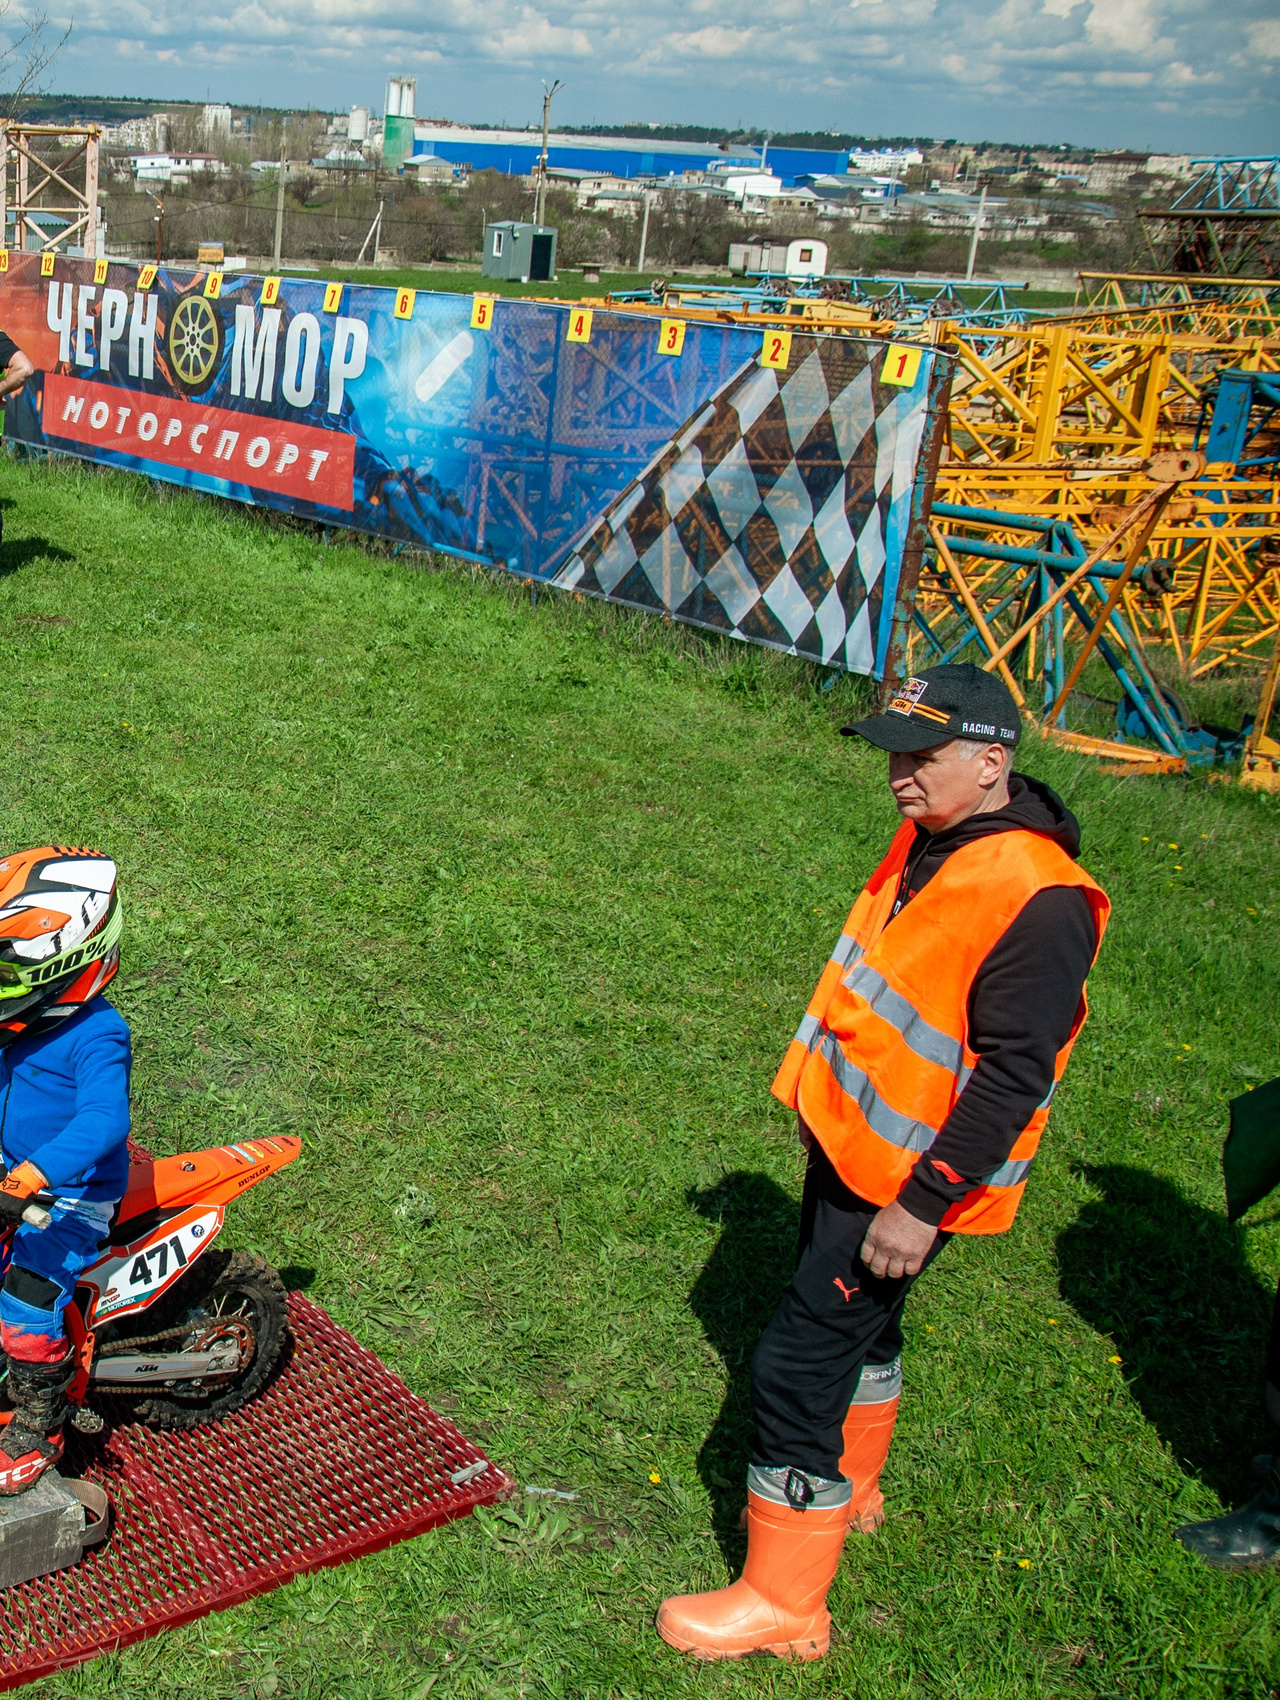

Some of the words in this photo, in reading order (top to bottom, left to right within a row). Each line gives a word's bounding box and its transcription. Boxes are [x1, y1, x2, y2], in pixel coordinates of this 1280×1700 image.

[44, 257, 52, 272] 12
[97, 265, 105, 279] 11
[140, 270, 153, 285] 10
[209, 278, 218, 294] 9
[265, 283, 274, 299] 8
[328, 290, 337, 307] 7
[399, 294, 408, 313] 6
[477, 304, 487, 325] 5
[574, 315, 584, 337] 4
[666, 326, 678, 349] 3
[769, 338, 782, 362] 2
[896, 353, 908, 378] 1
[61, 395, 329, 482] МОТОРСПОРТ
[962, 722, 995, 736] RACING
[1000, 728, 1015, 740] TEAM
[26, 933, 107, 985] 100%
[238, 1165, 271, 1188] DUNLOP
[129, 1235, 188, 1285] 471
[107, 1296, 136, 1312] MOTOREX
[135, 1365, 159, 1373] KTM
